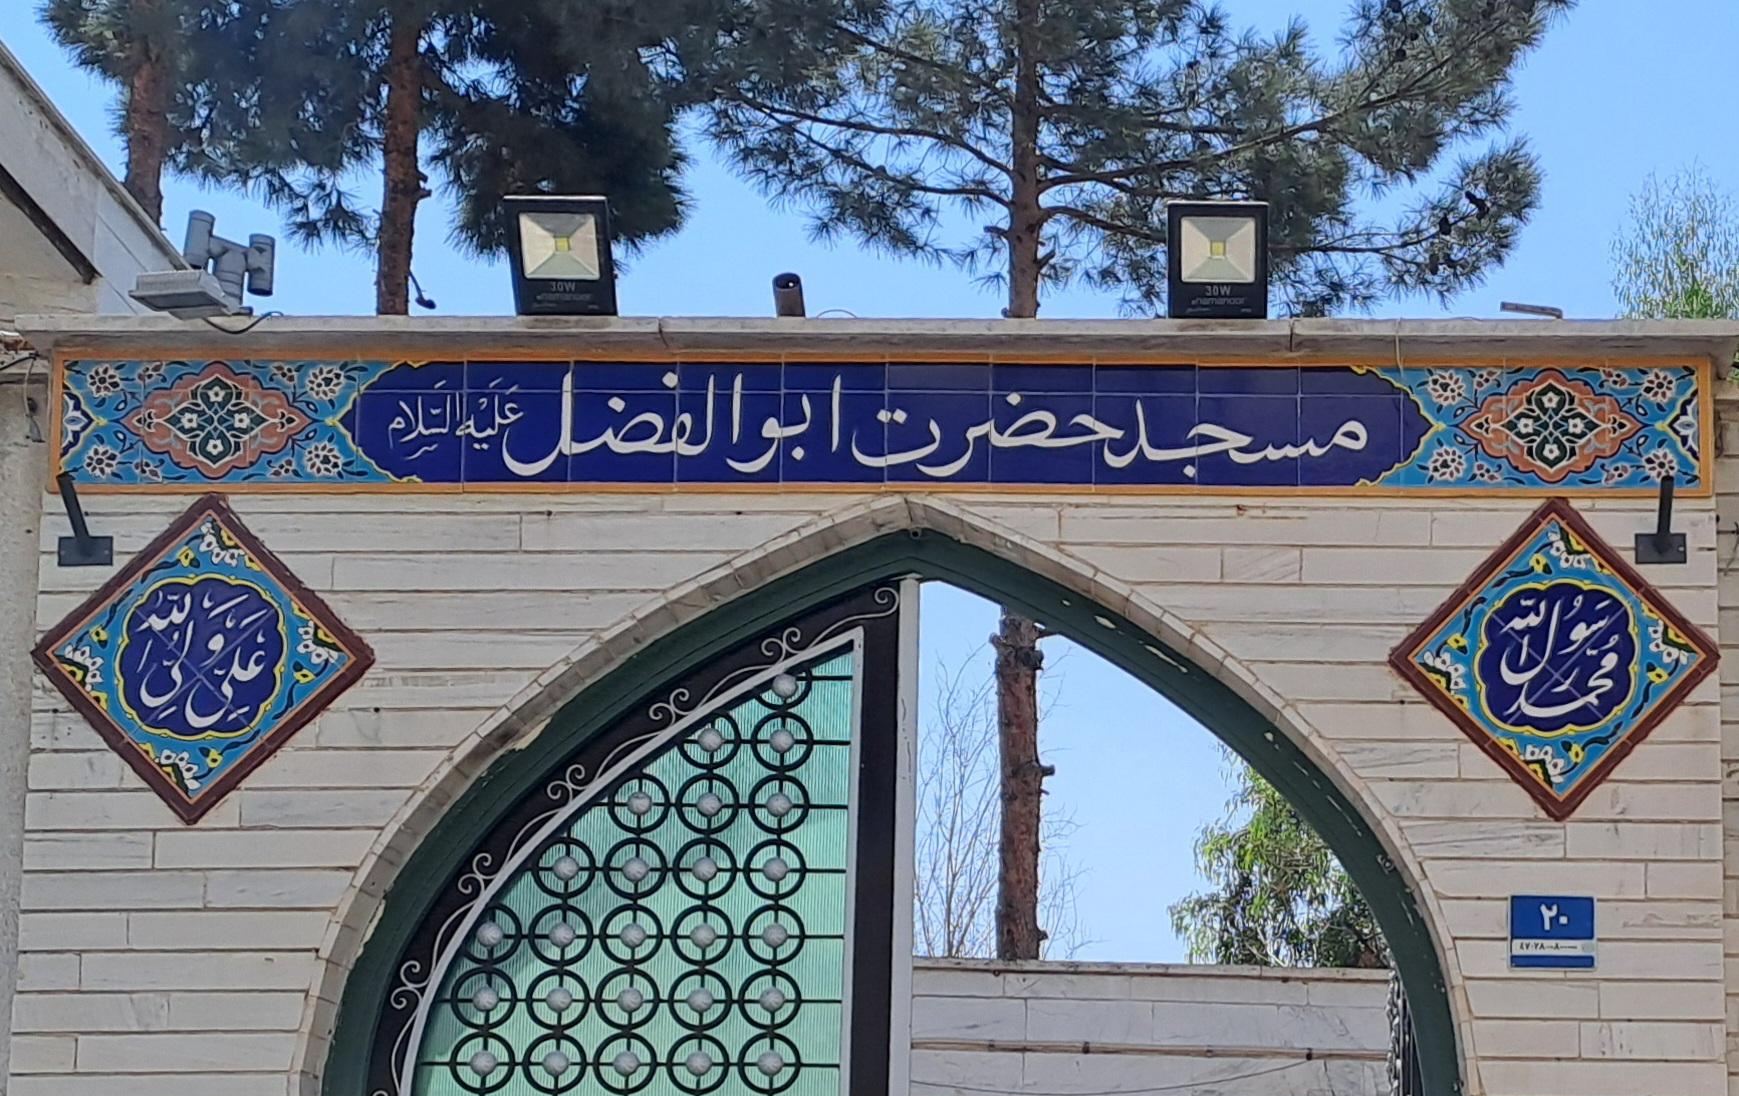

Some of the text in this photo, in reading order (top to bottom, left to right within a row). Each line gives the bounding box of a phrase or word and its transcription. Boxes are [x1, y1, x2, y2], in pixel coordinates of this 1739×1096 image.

[549, 281, 576, 292] 30W
[1204, 285, 1232, 296] 30W
[851, 391, 1126, 478] حضرت
[1102, 398, 1369, 478] مسجد
[1539, 903, 1569, 931] ۲۰
